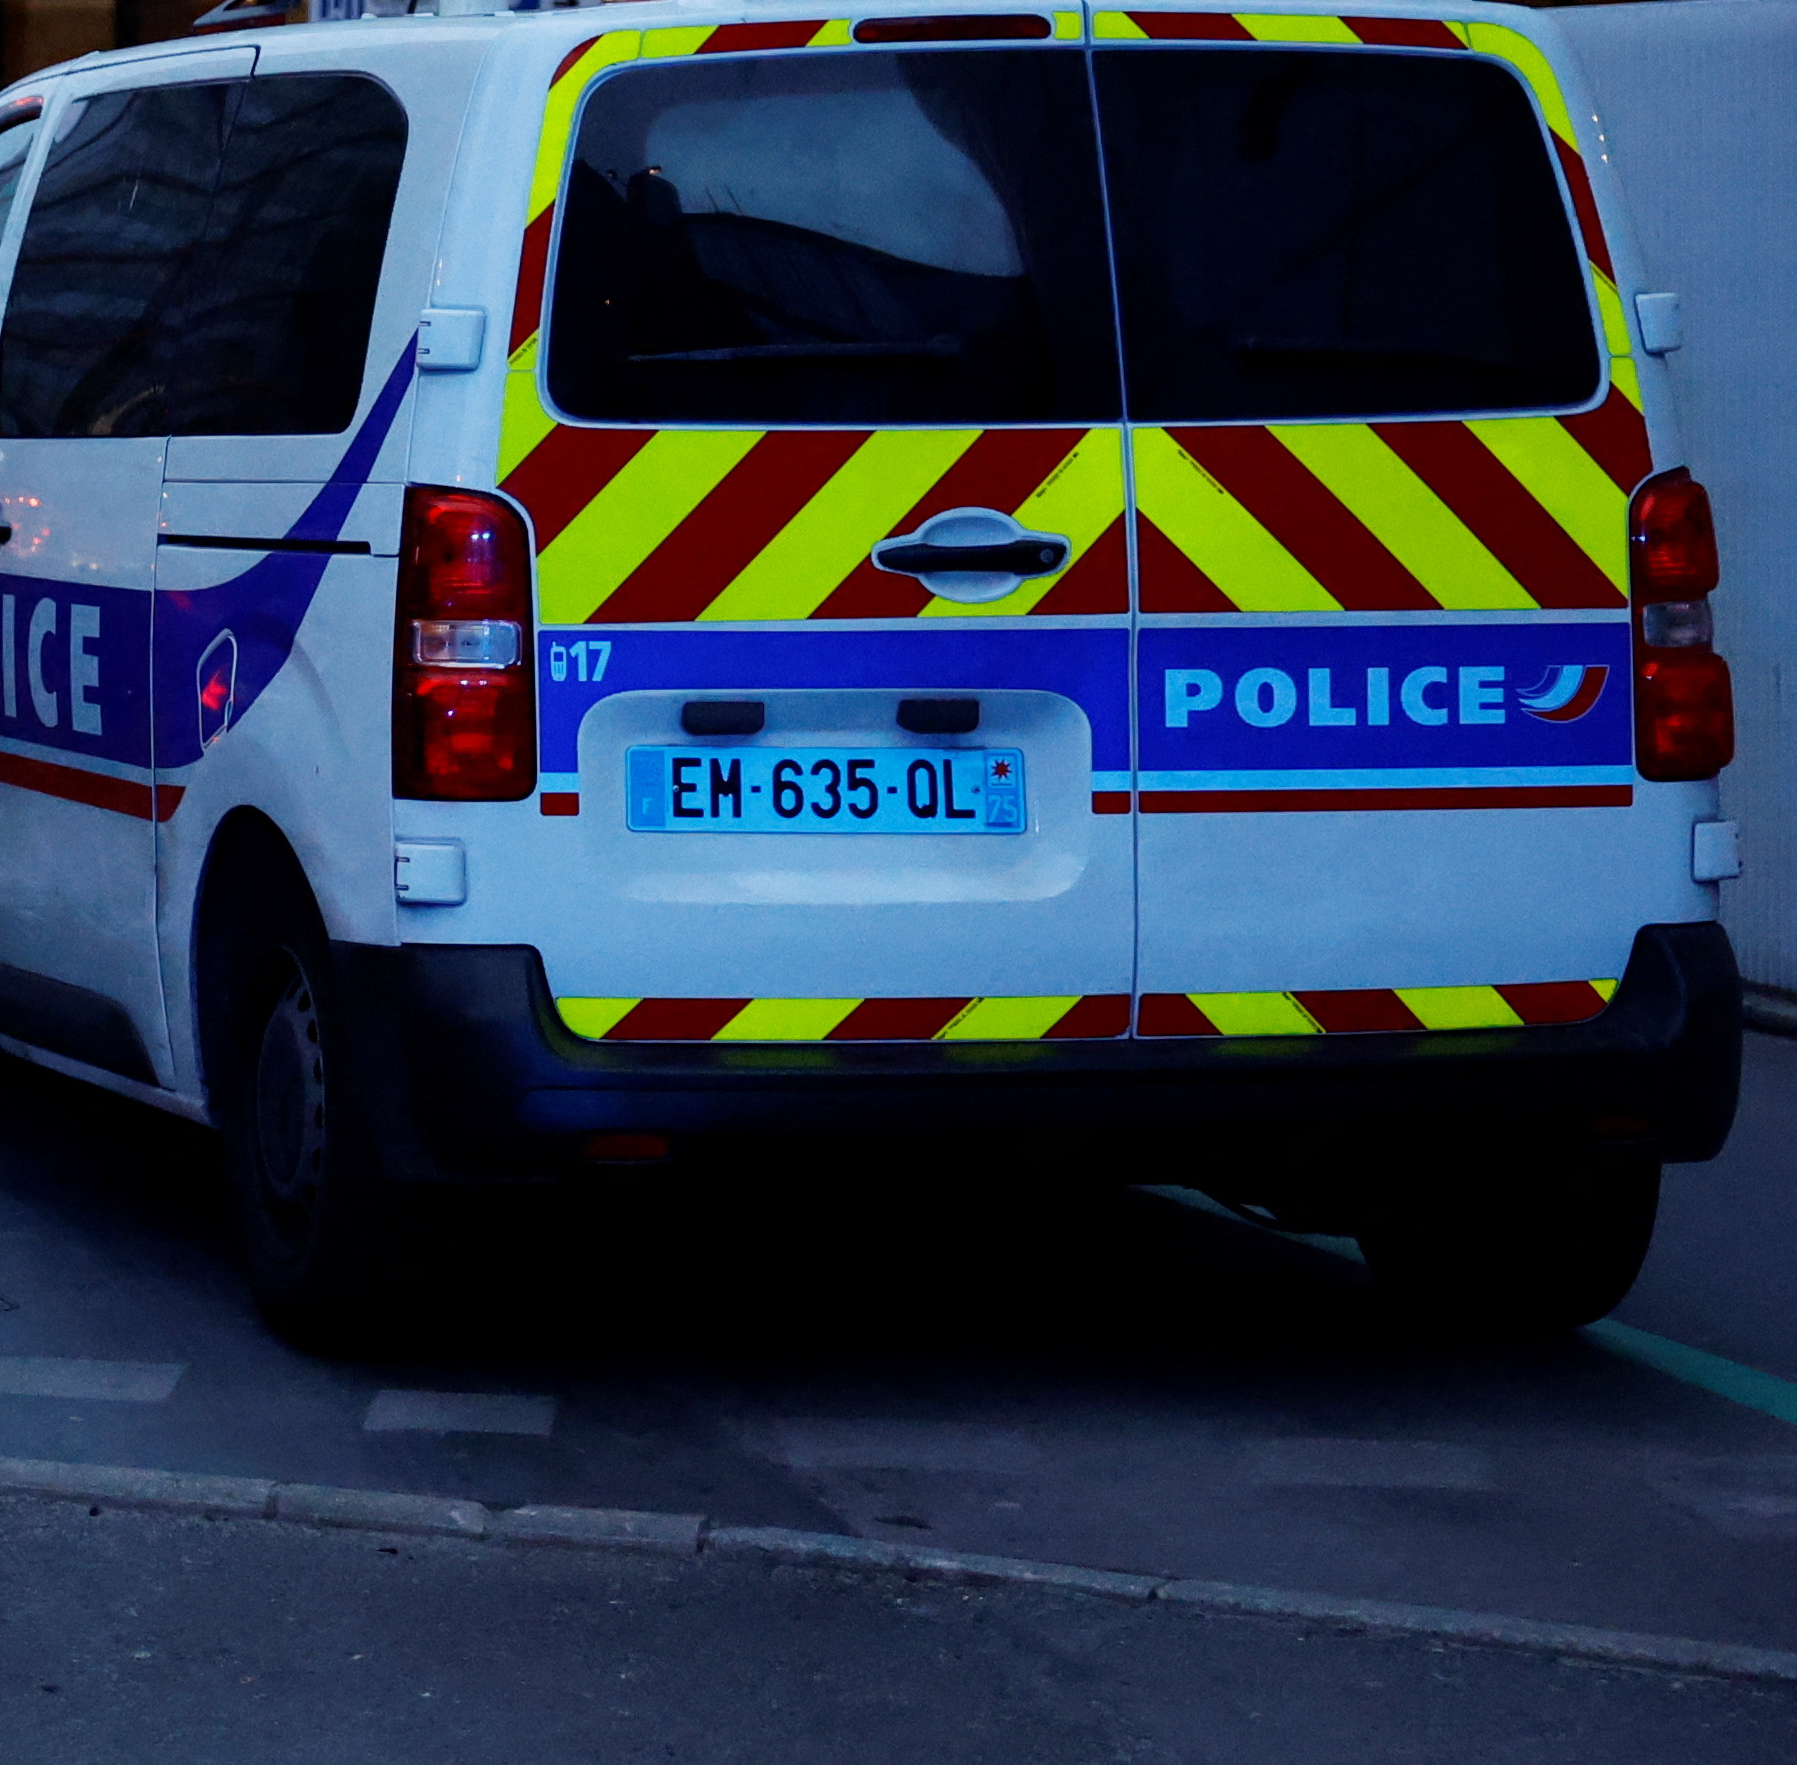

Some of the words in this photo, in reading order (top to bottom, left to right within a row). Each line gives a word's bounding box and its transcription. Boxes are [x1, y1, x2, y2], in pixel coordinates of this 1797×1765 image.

[570, 640, 612, 681] 17
[1165, 666, 1505, 727] POLICE
[672, 757, 976, 819] EM-635-QL
[987, 795, 1017, 822] 75
